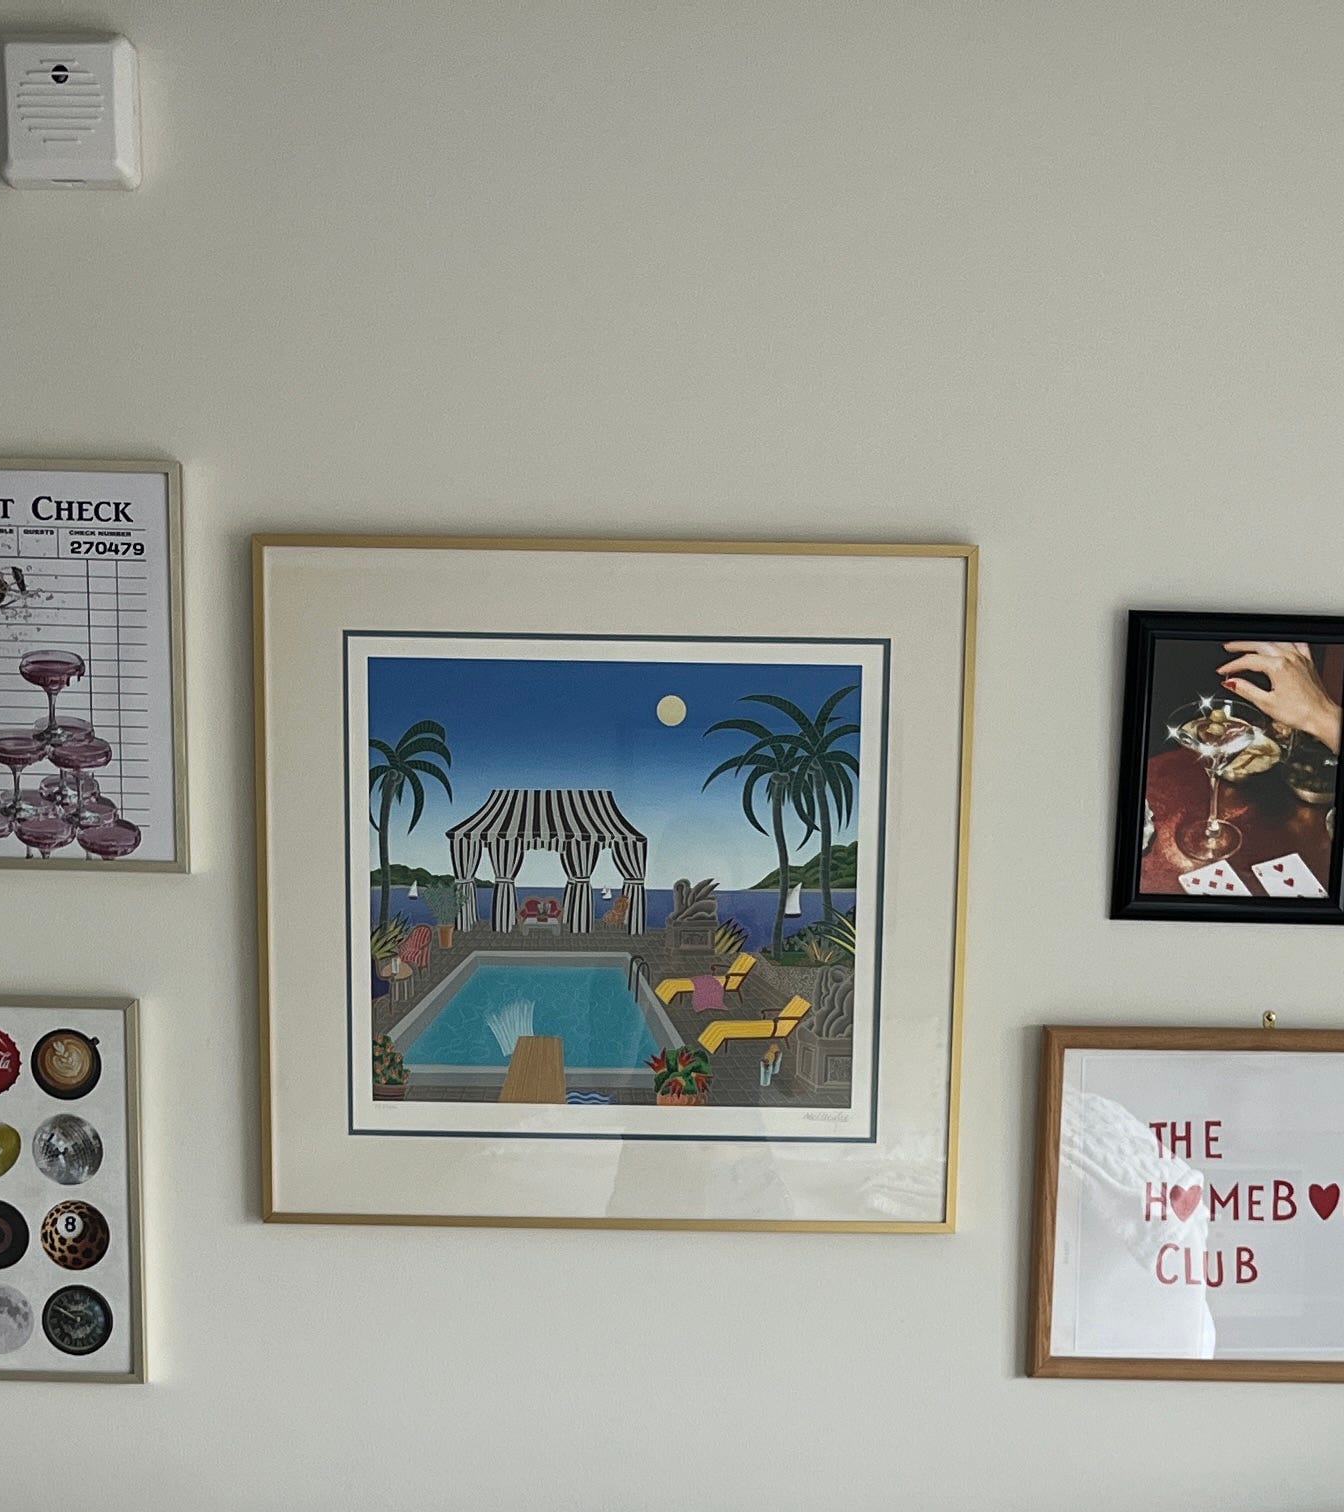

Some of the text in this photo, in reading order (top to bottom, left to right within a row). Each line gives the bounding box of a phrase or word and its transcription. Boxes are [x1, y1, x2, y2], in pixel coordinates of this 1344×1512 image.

[31, 495, 134, 523] CHECK
[70, 540, 145, 556] 270479
[1148, 1120, 1223, 1160] THE
[65, 1215, 76, 1233] 8
[1155, 1242, 1258, 1288] CLUB
